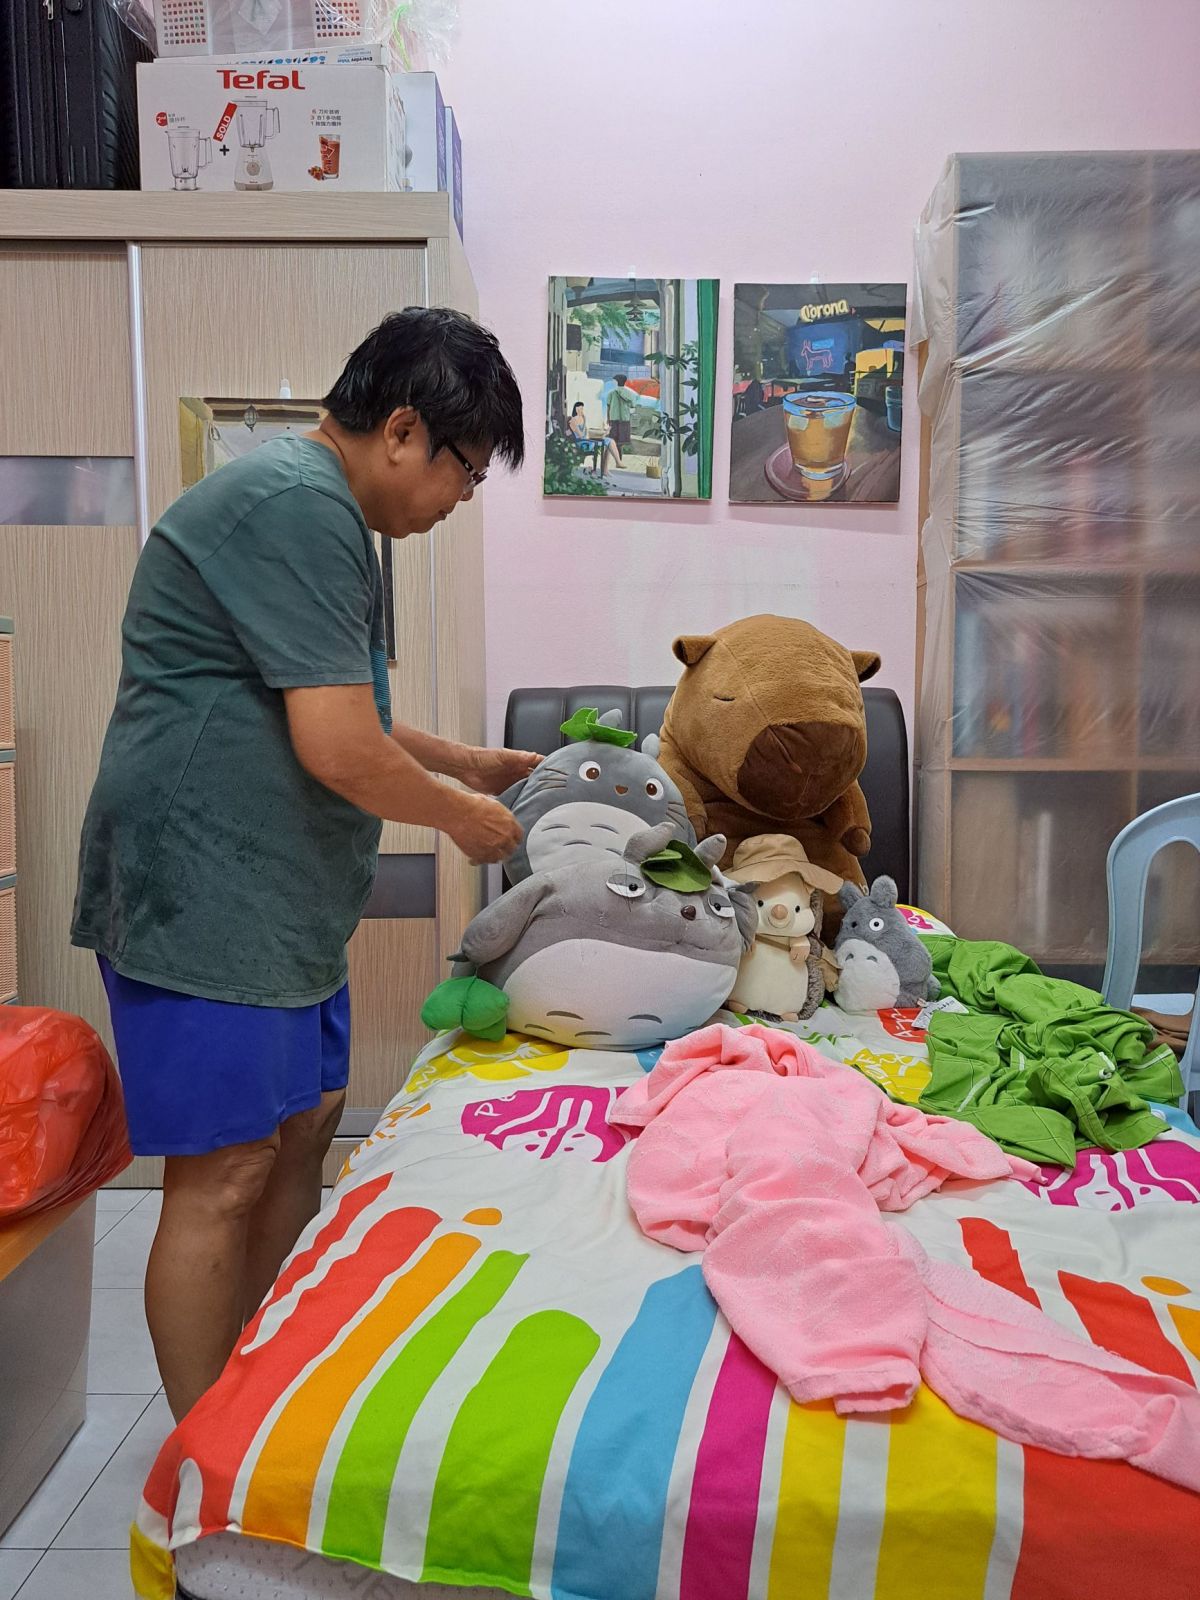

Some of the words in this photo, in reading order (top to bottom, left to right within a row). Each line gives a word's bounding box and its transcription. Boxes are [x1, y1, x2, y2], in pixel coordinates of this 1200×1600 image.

[216, 70, 305, 90] Tefal
[216, 115, 231, 140] SOLD
[800, 299, 849, 323] Corona
